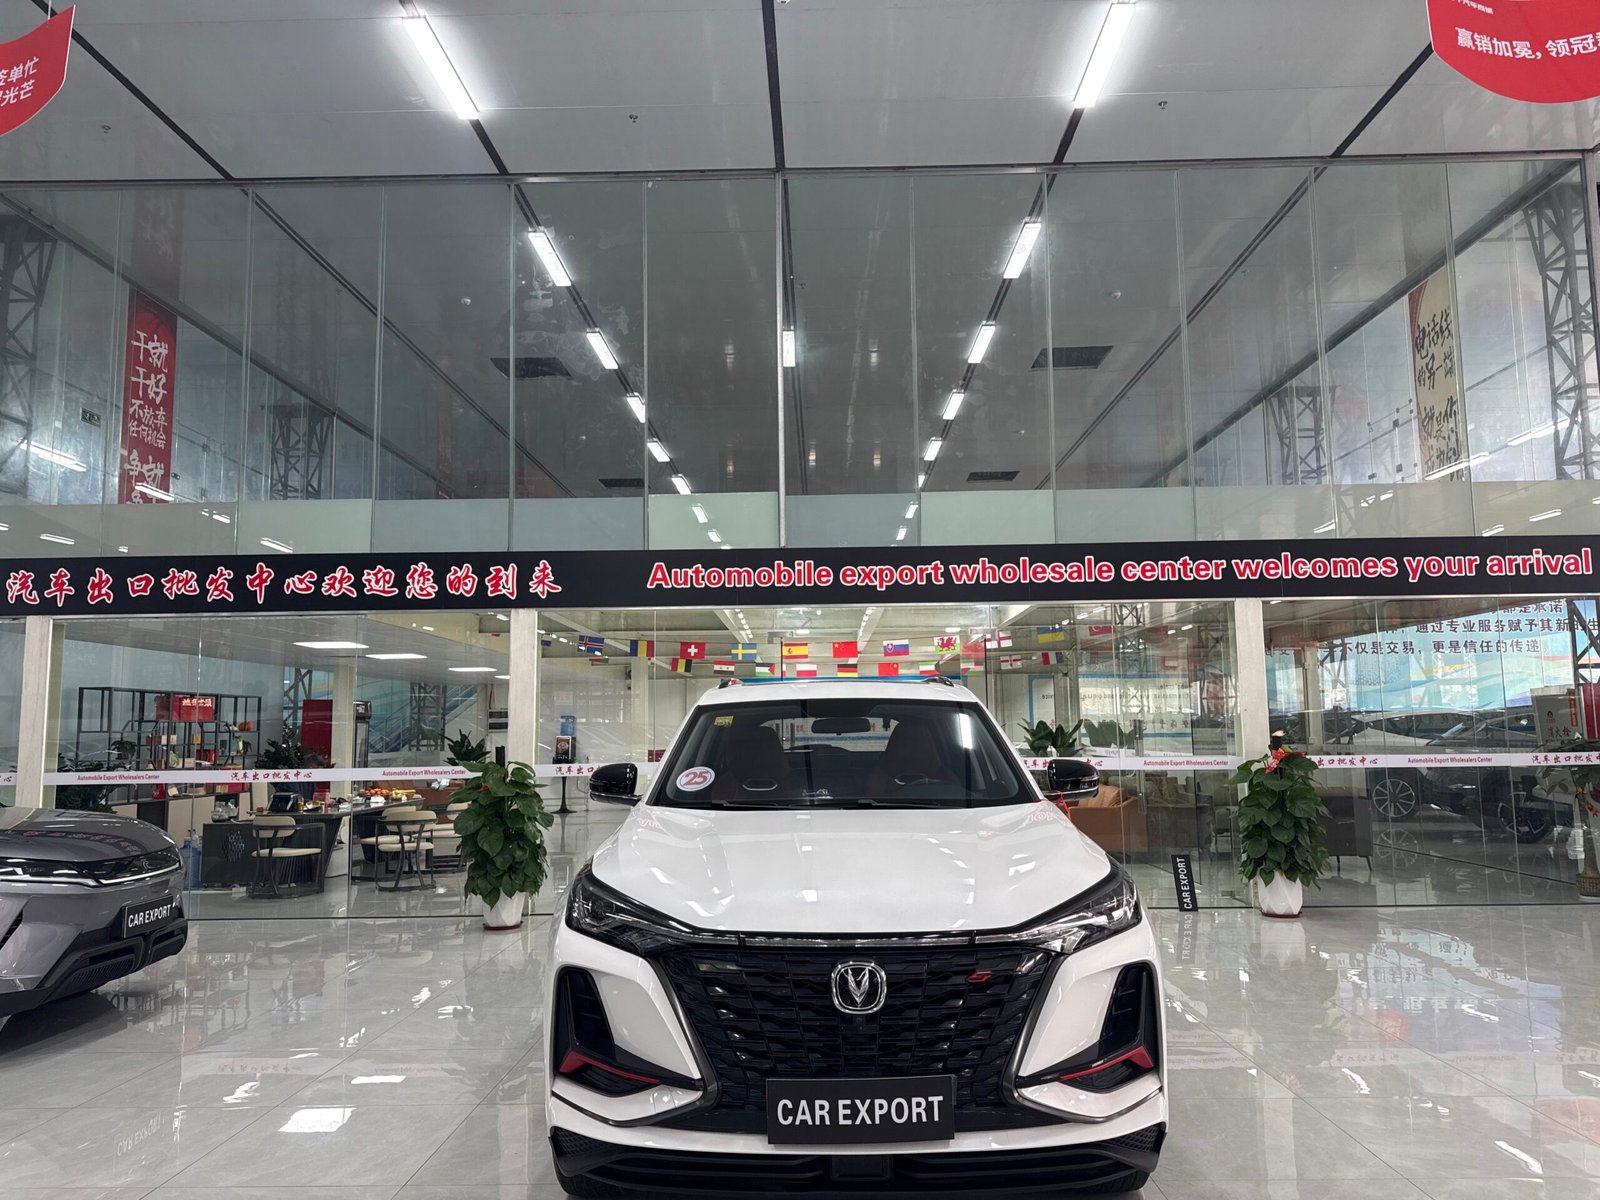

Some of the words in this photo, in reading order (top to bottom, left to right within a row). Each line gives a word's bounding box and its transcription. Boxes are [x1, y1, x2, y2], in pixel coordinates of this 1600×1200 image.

[0, 79, 36, 107] 光芒
[6, 558, 562, 608] 汽车出口批发中心欢迎您的到来
[647, 560, 832, 589] Automobile
[839, 560, 945, 591] export
[949, 556, 1116, 585] wholesale
[1120, 555, 1226, 583] center
[1233, 551, 1400, 581] welcomes
[1403, 552, 1481, 583] your
[1486, 547, 1592, 577] arrival
[230, 769, 313, 781] 汽车出口批发中心
[683, 769, 710, 786] 25
[1176, 857, 1190, 891] EXPORT
[1183, 890, 1193, 910] CAR
[128, 912, 144, 928] CAR
[144, 904, 171, 923] EXPORT
[777, 1099, 831, 1126] CAR
[838, 1095, 944, 1126] EXPORT
